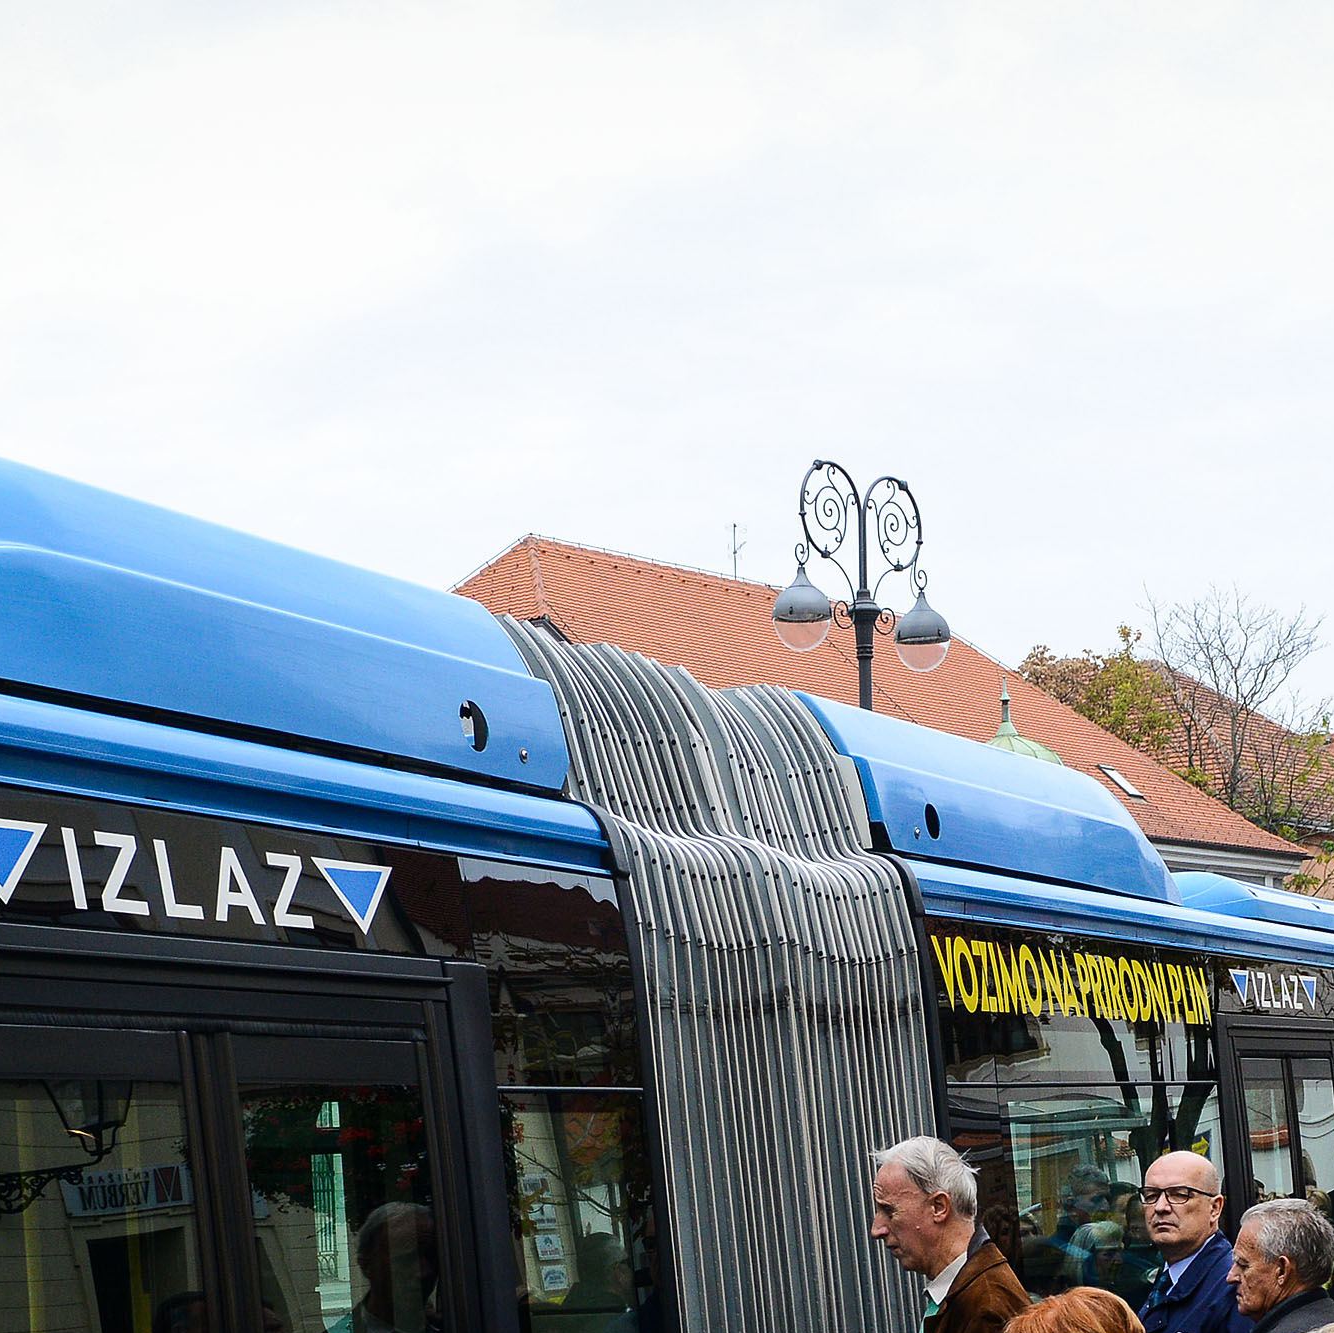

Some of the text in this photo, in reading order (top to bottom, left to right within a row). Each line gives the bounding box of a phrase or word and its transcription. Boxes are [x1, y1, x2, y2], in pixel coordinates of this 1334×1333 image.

[61, 827, 315, 929] IZLAZ
[931, 935, 1213, 1027] VOZIMO NA PRIRODNI PLIN
[1250, 971, 1304, 1010] IZLAZ
